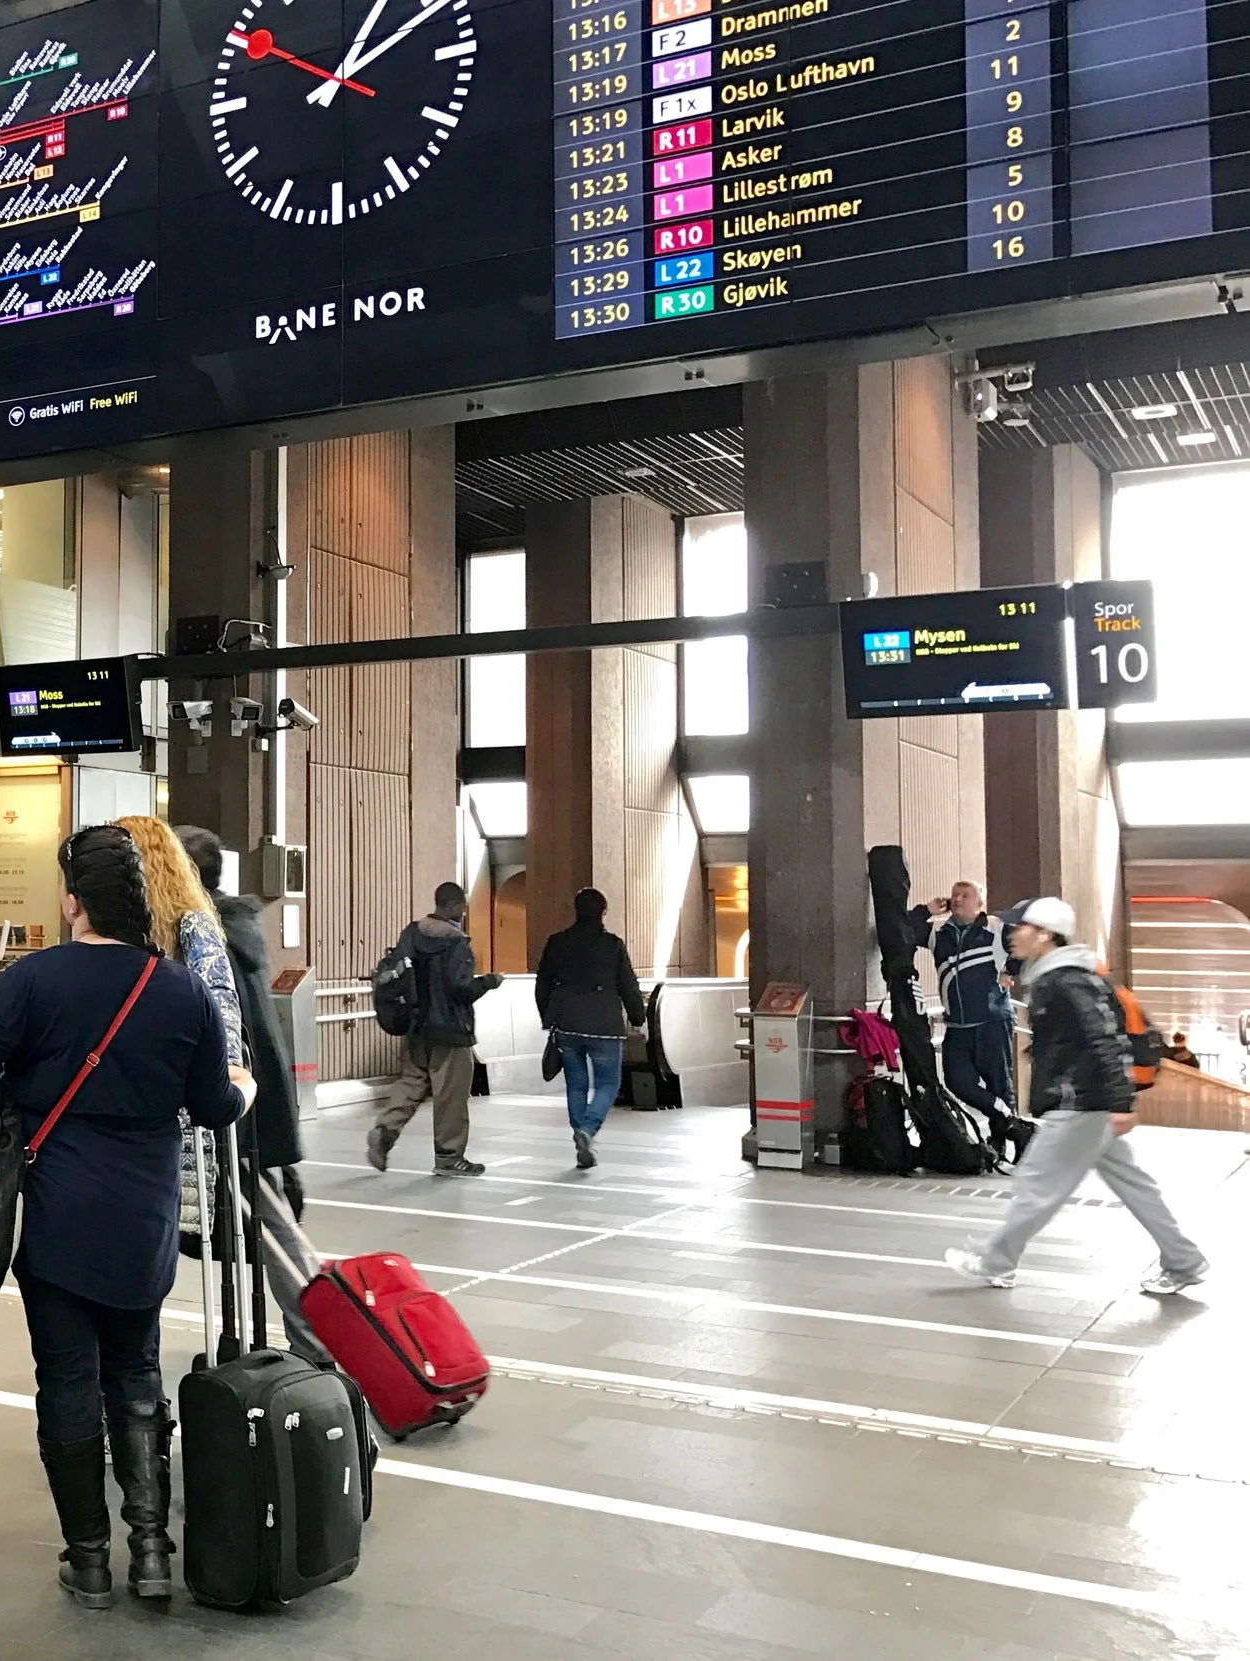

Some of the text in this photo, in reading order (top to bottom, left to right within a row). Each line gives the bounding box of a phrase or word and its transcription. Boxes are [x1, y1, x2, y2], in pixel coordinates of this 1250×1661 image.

[569, 11, 627, 40] 13:16
[569, 0, 829, 72] 13:17 F 2 Drammen
[569, 43, 776, 103] 13:19 L 21 Moss
[569, 19, 1020, 137] 13:19 F 1x Oslo Lufthavn 2
[570, 55, 1018, 168] 13:21 R 11 Larvik 11
[570, 91, 1022, 200] 13:23 L 1 Asker 9
[570, 126, 1023, 231] 13:24 L 1 Lillestrøm 8
[570, 164, 1022, 265] 13:26 R 10 Lillehammer 5
[571, 200, 1025, 297] 13:29 L 22 Skøyen 10
[571, 236, 1024, 328] 13:30 R 30 Gjøvik 16
[255, 287, 425, 344] BANE NOR
[30, 391, 138, 419] Gratis WiFi Free WiFi
[914, 629, 966, 647] Mysen
[1094, 601, 1134, 619] Spor
[1095, 616, 1141, 632] Track
[870, 650, 905, 663] 13:31
[1090, 642, 1149, 684] 10
[13, 705, 35, 714] 13:18
[39, 689, 63, 701] Moss
